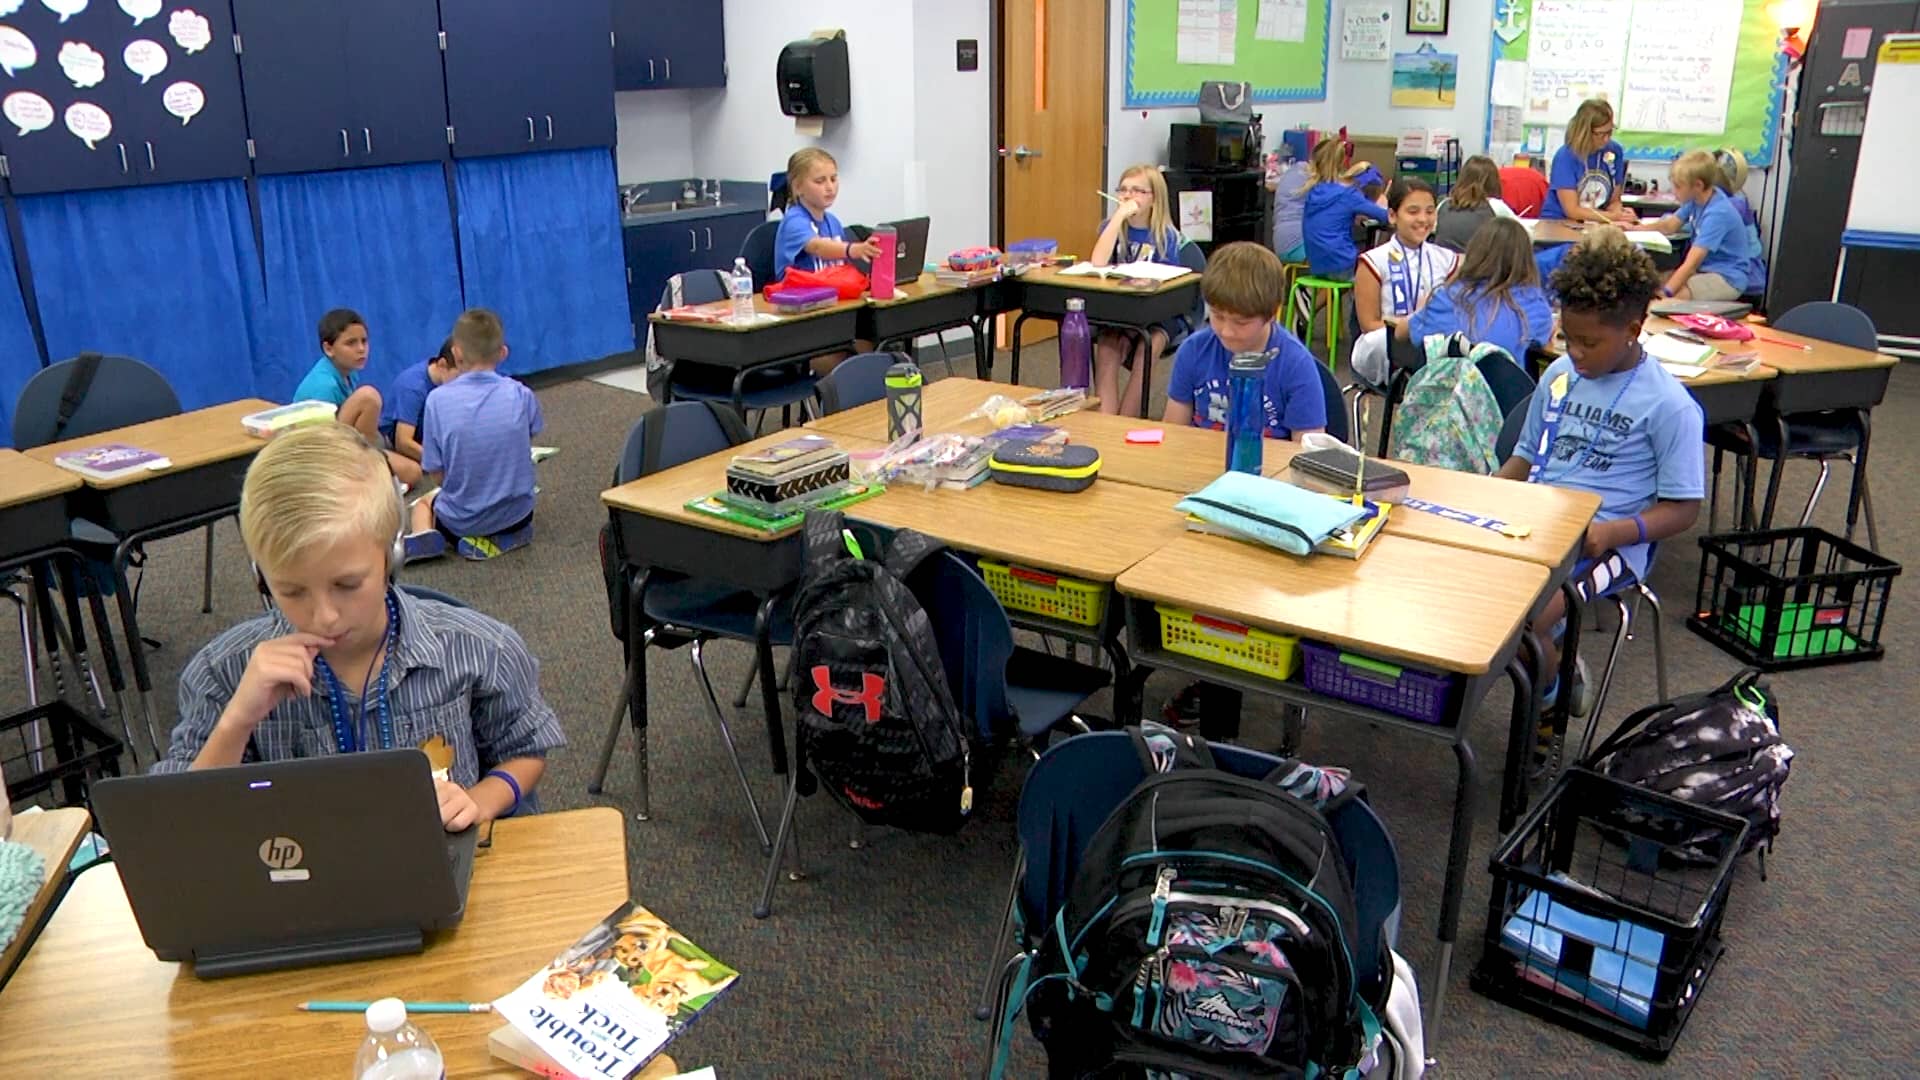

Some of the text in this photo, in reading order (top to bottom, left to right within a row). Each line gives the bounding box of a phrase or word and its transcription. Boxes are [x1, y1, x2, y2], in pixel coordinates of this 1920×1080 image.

[1838, 63, 1861, 86] A
[266, 837, 296, 869] hp
[529, 1004, 623, 1078] Trouble
[576, 1002, 640, 1056] Tuck
